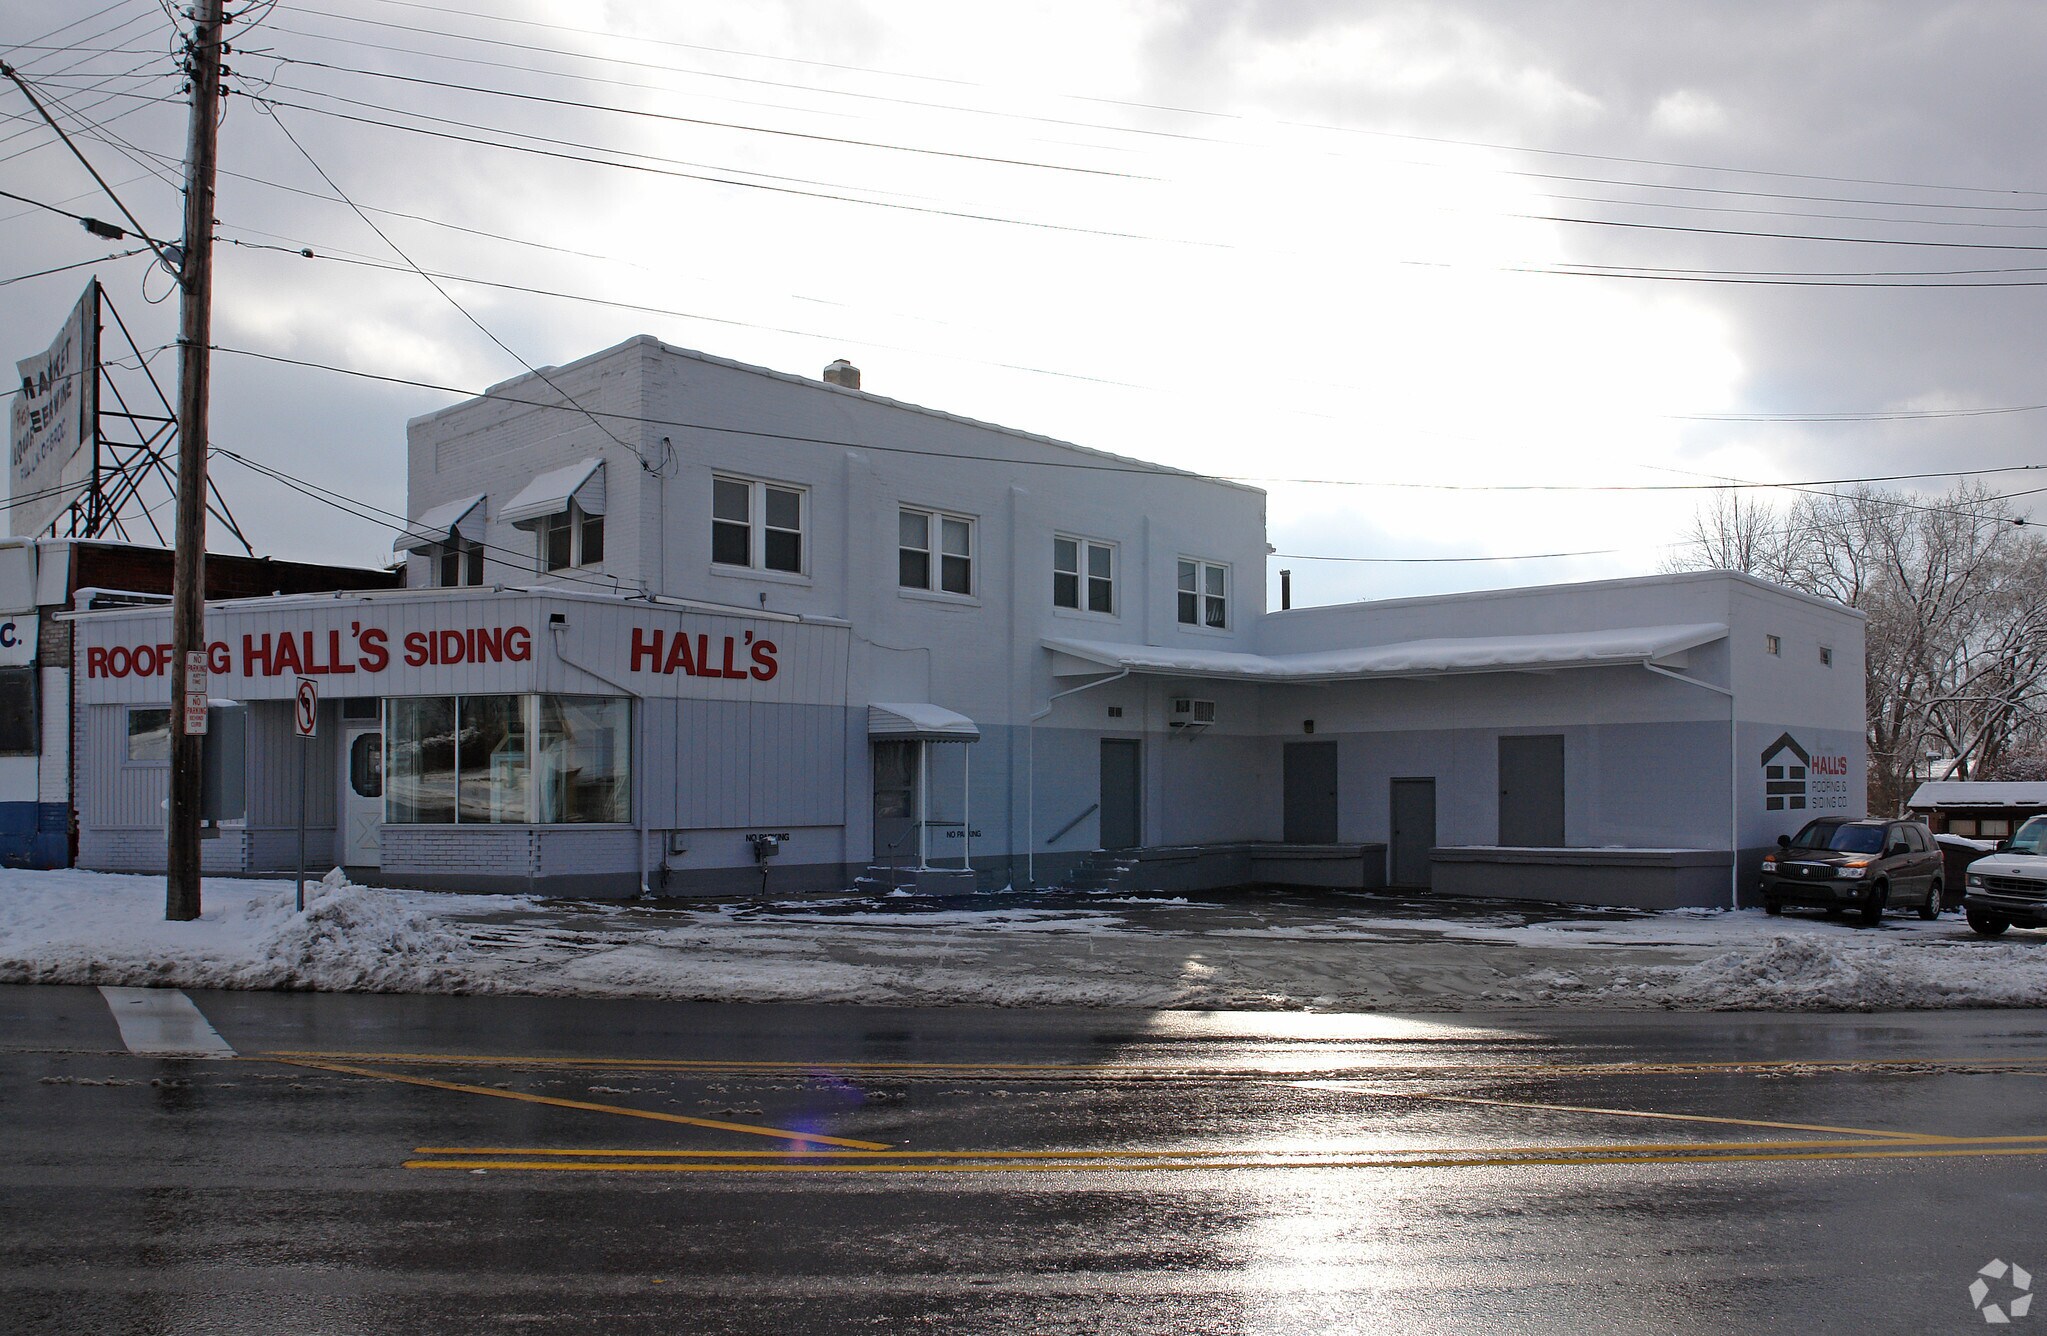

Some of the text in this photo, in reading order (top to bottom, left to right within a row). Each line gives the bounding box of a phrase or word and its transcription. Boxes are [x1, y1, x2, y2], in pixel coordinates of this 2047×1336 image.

[88, 621, 531, 678] ROOFG HALL'S SIDING
[631, 628, 778, 681] HALL'S
[193, 656, 202, 664] NO
[192, 698, 201, 706] NO
[187, 707, 207, 715] PARKING
[745, 833, 757, 842] NO
[957, 830, 982, 838] PAKING
